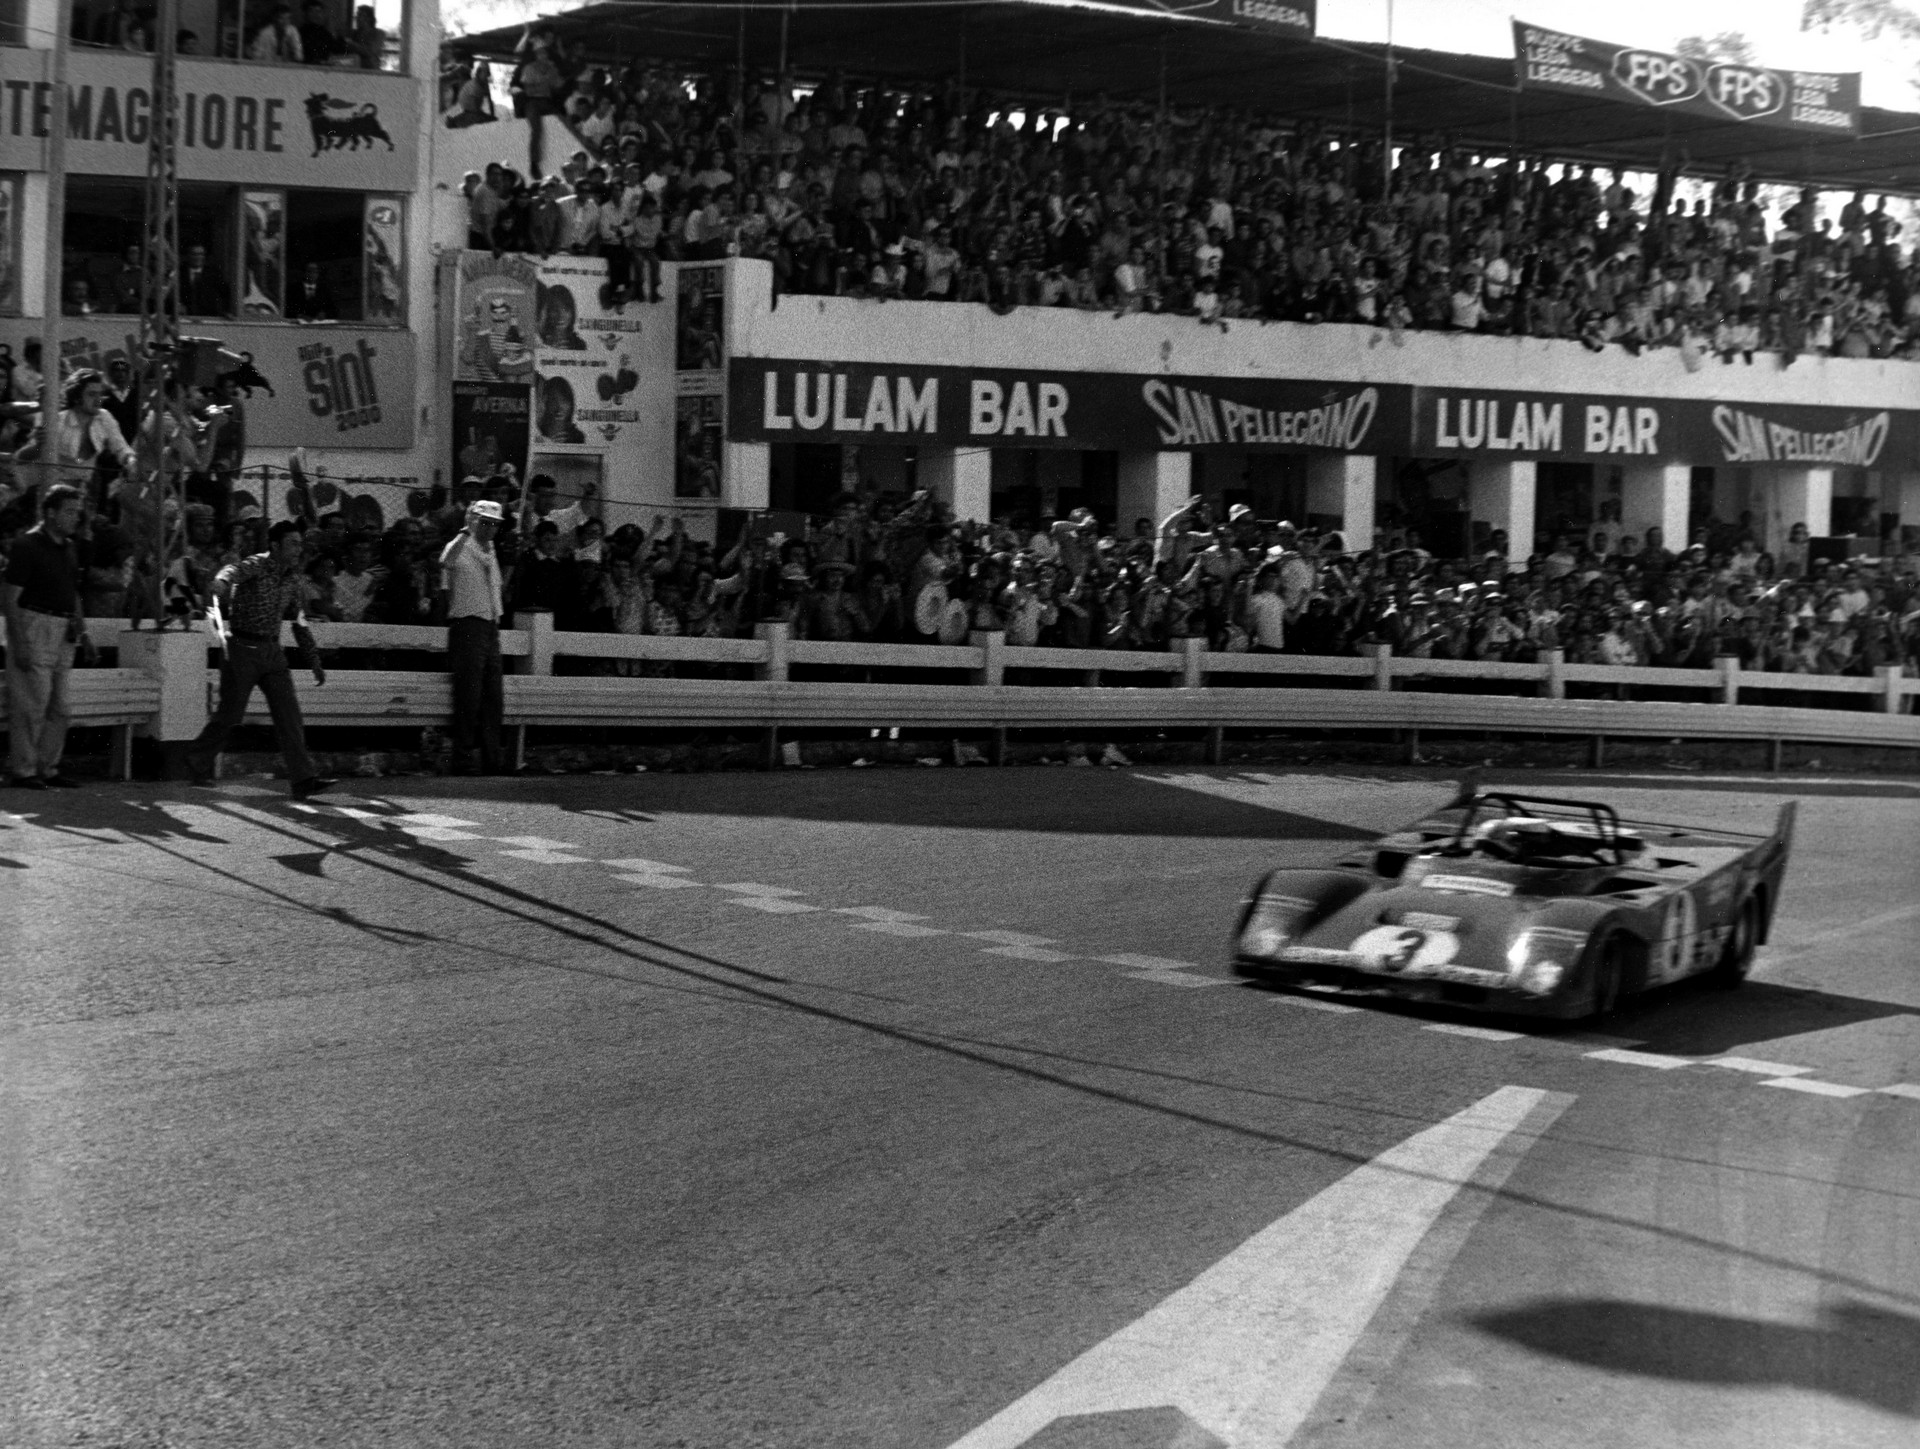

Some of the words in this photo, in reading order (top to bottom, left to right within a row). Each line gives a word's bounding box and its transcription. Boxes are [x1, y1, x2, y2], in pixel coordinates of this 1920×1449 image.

[1626, 54, 1688, 95] FPS
[1719, 68, 1772, 109] FPS
[303, 339, 377, 416] sint
[763, 371, 939, 434] LULAM
[969, 380, 1069, 438] BAR
[1142, 379, 1220, 445] SAN
[1220, 386, 1379, 450] PELLEGRINO
[1435, 398, 1563, 452] LULAM
[1584, 405, 1660, 455] BAR
[1711, 404, 1769, 462] SAN
[1768, 411, 1890, 467] PELLEGRINO
